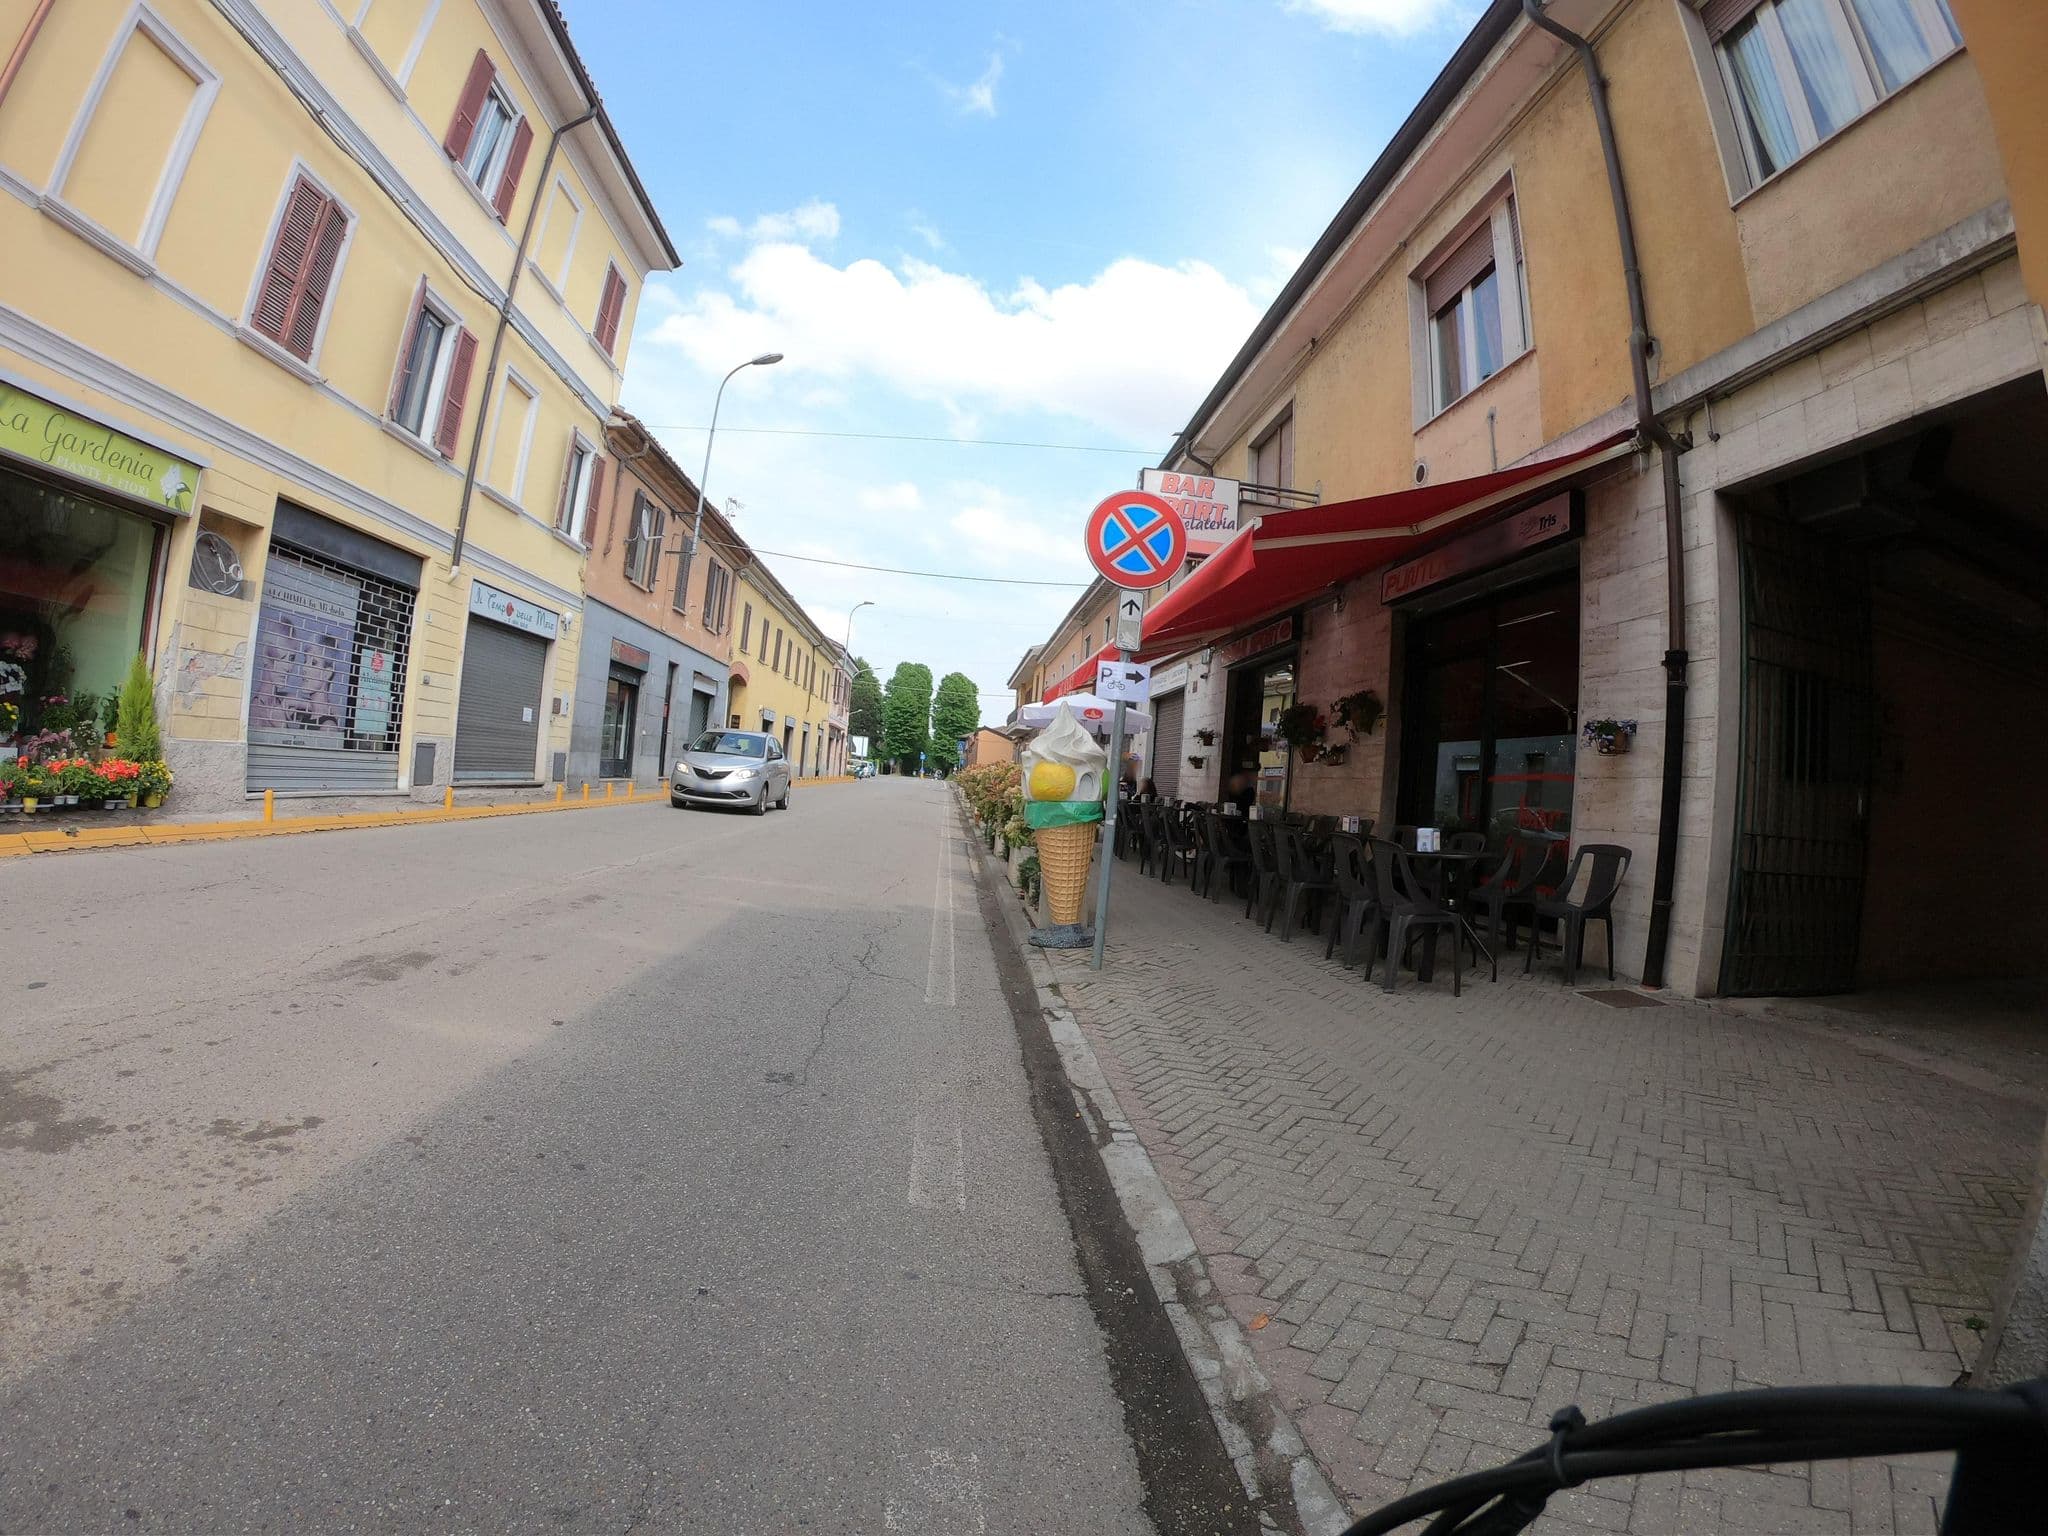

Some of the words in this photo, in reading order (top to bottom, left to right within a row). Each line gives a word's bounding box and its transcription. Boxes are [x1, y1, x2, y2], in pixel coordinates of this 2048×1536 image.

[40, 412, 154, 482] Gardenia
[118, 479, 150, 497] FIORI
[1160, 473, 1215, 499] BAR
[1161, 496, 1228, 522] PORT
[1184, 517, 1235, 530] elateria
[1539, 513, 1557, 531] Tris
[1100, 667, 1113, 682] P
